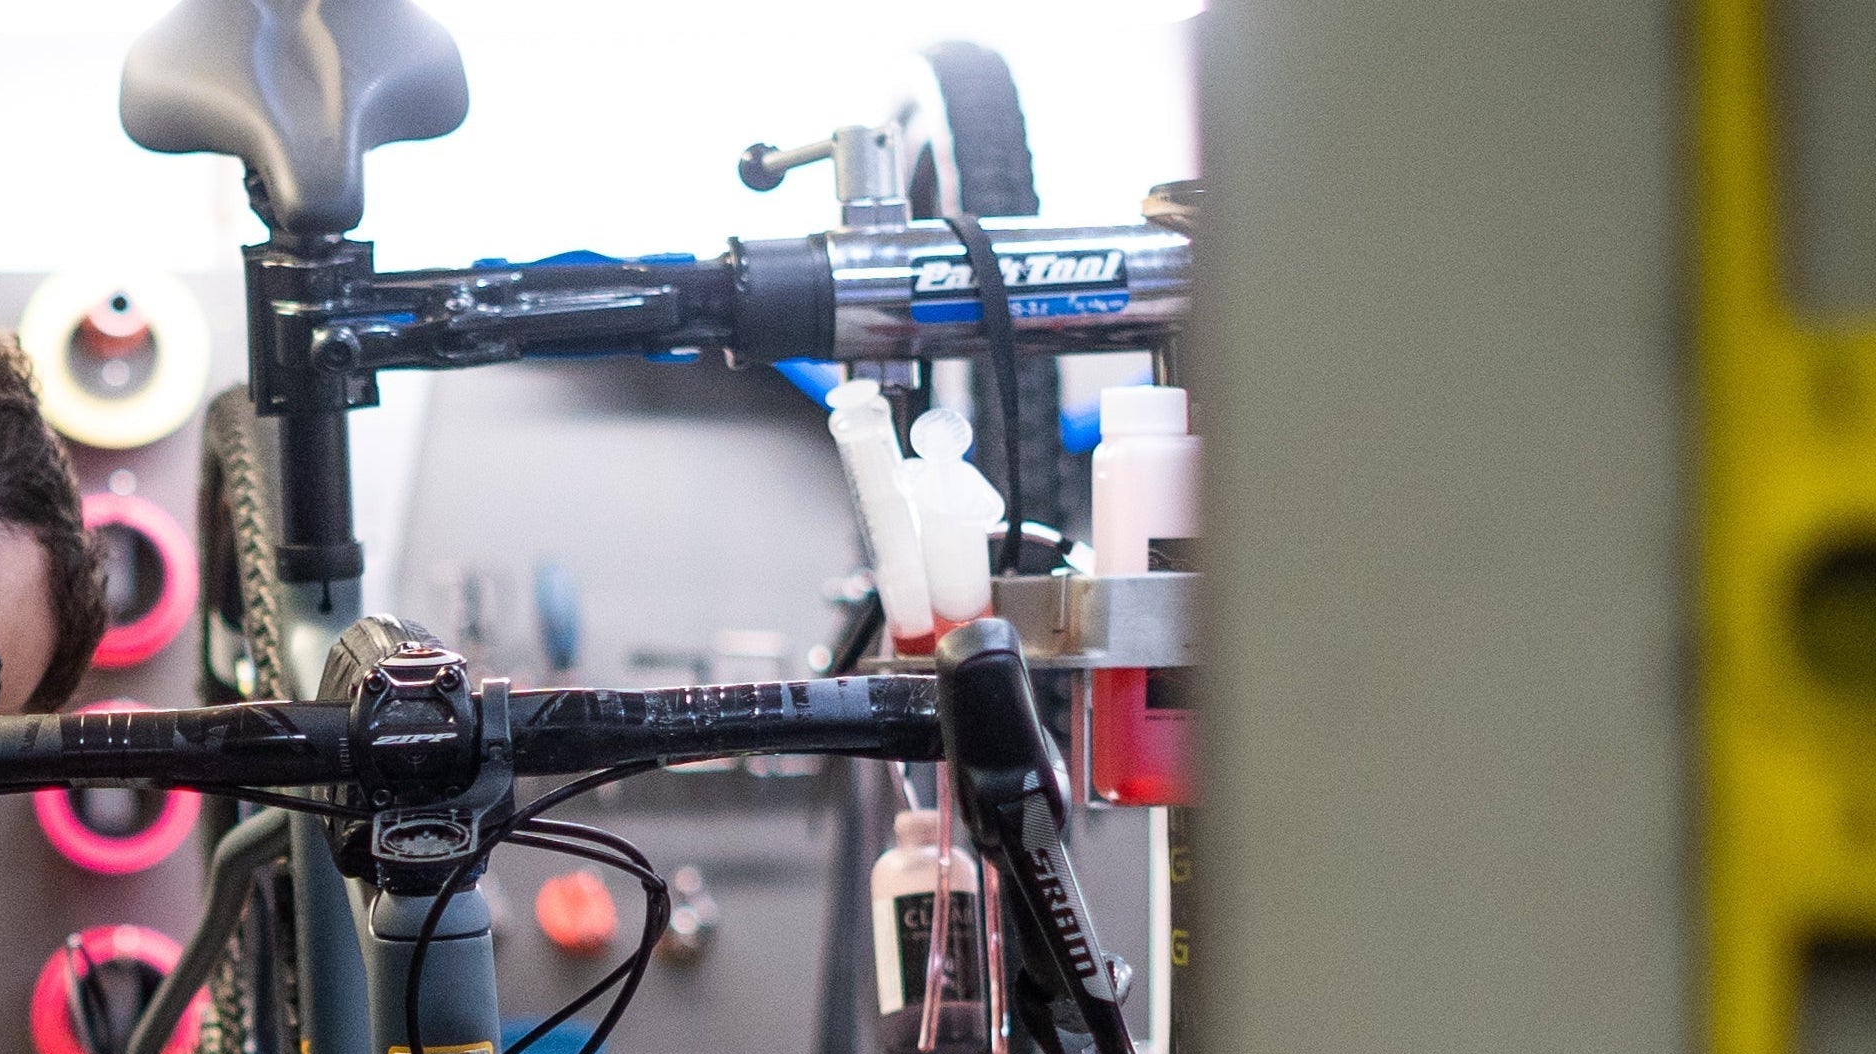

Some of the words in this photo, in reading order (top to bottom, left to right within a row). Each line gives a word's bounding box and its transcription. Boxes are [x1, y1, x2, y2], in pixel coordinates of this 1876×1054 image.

[915, 258, 1025, 292] Pak
[1025, 251, 1122, 285] Tool
[372, 732, 458, 746] ZIPP
[1030, 848, 1097, 979] SRAM
